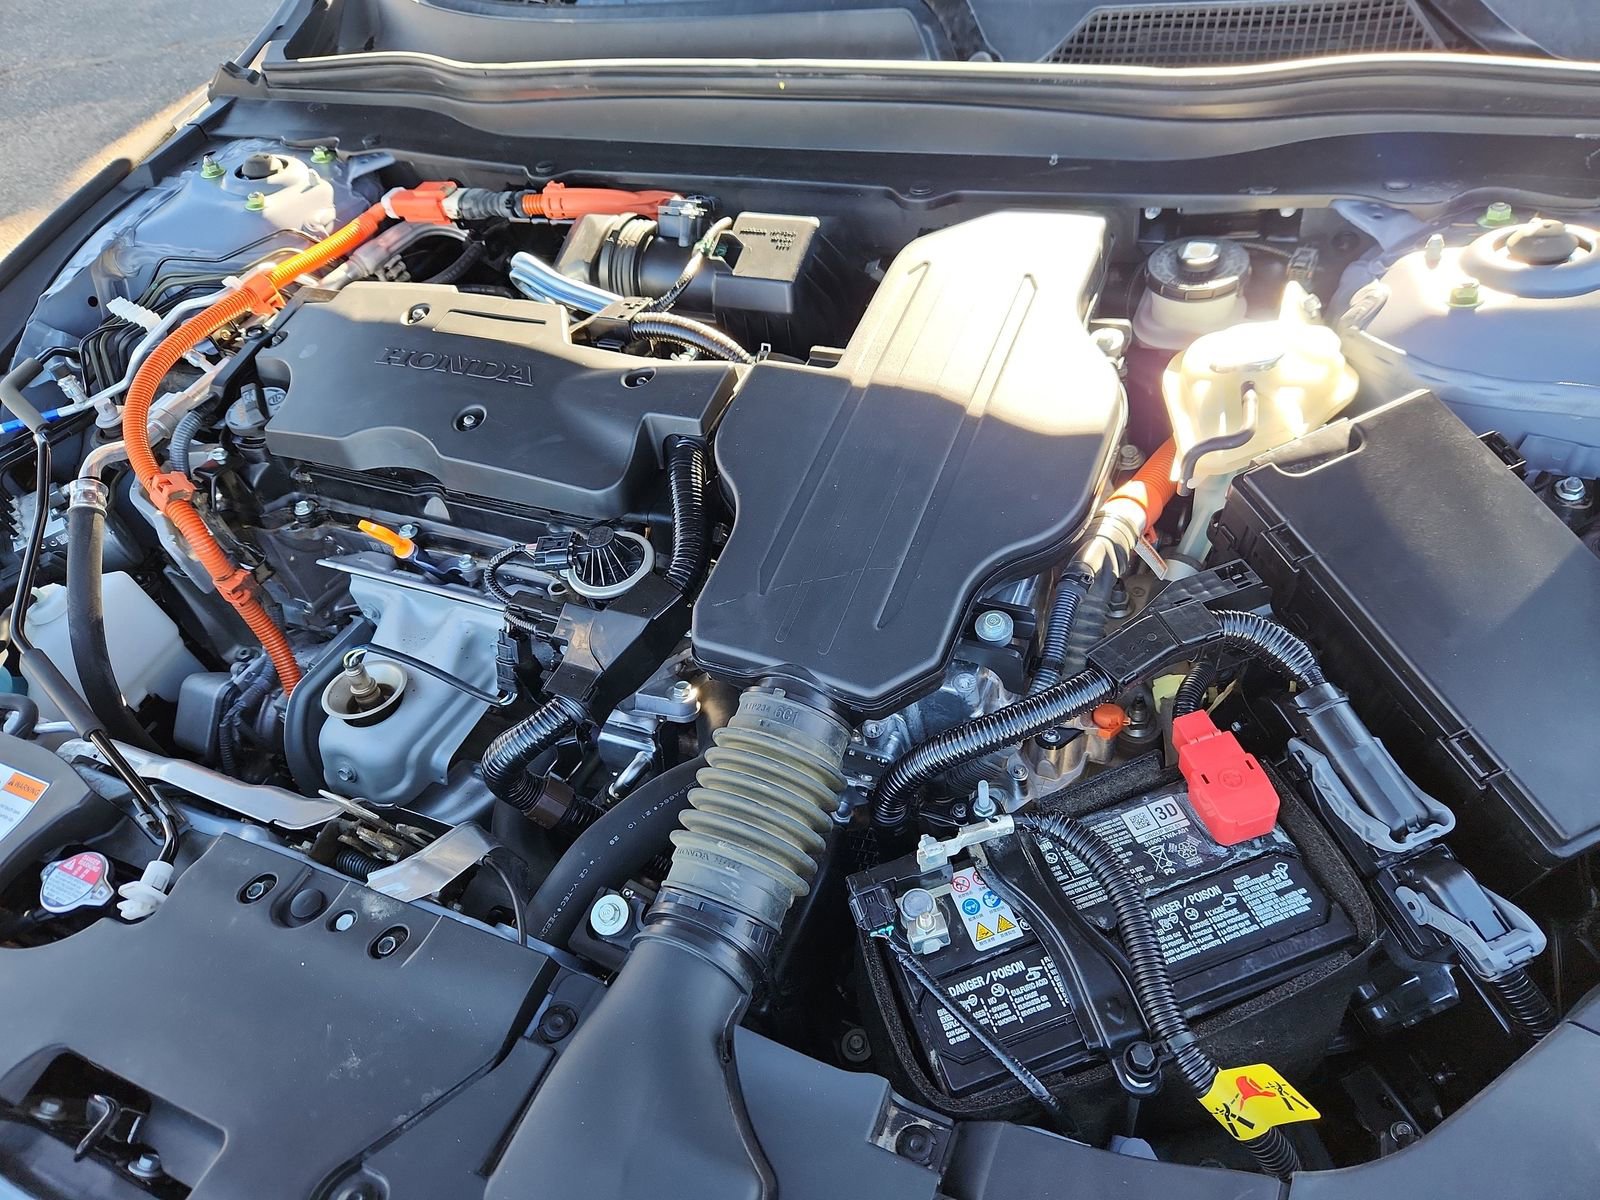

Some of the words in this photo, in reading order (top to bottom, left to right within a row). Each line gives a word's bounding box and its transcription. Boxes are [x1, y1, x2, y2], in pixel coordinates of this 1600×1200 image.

[375, 347, 533, 387] HONDA
[1154, 802, 1179, 821] 3D
[1144, 829, 1164, 840] GROUP
[1164, 867, 1176, 875] Pb
[988, 997, 997, 1005] NO
